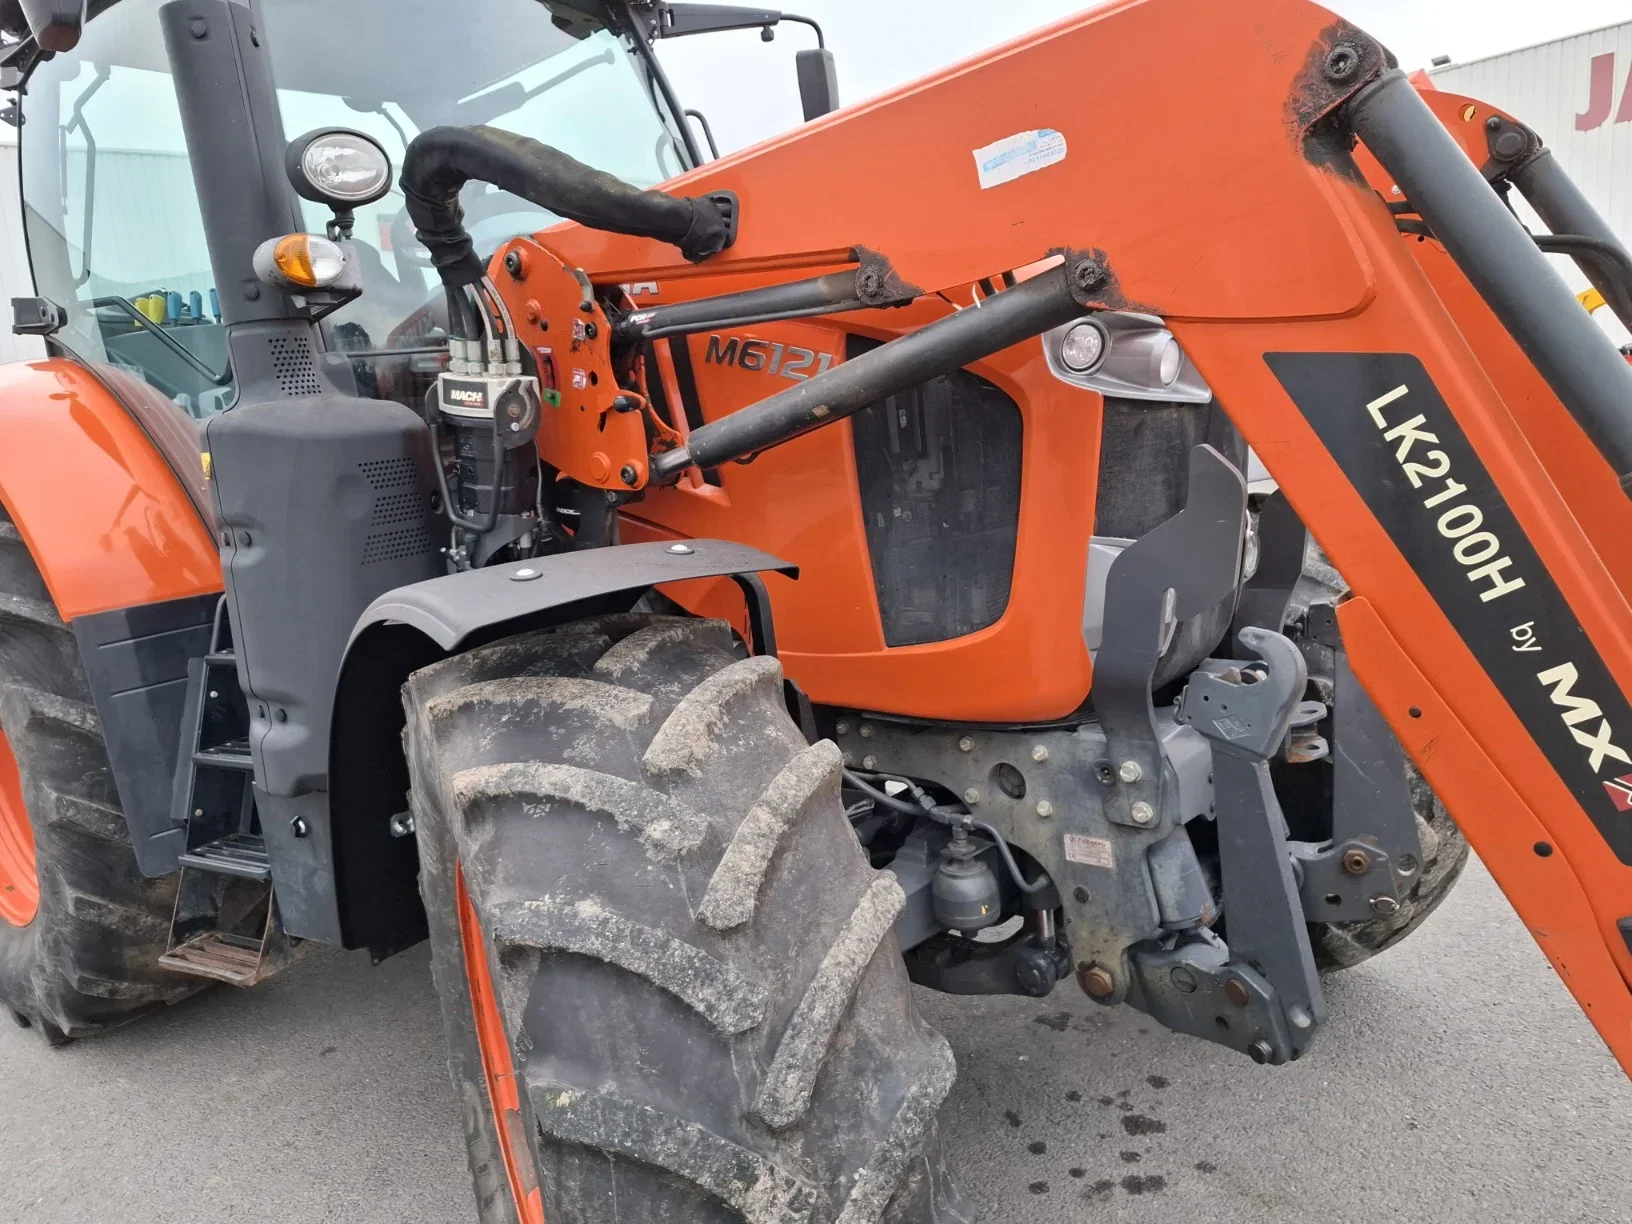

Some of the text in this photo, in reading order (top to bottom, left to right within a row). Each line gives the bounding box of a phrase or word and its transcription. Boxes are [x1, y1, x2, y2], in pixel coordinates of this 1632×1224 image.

[705, 334, 832, 381] M6121
[1366, 384, 1632, 774] LK2100H by MX
